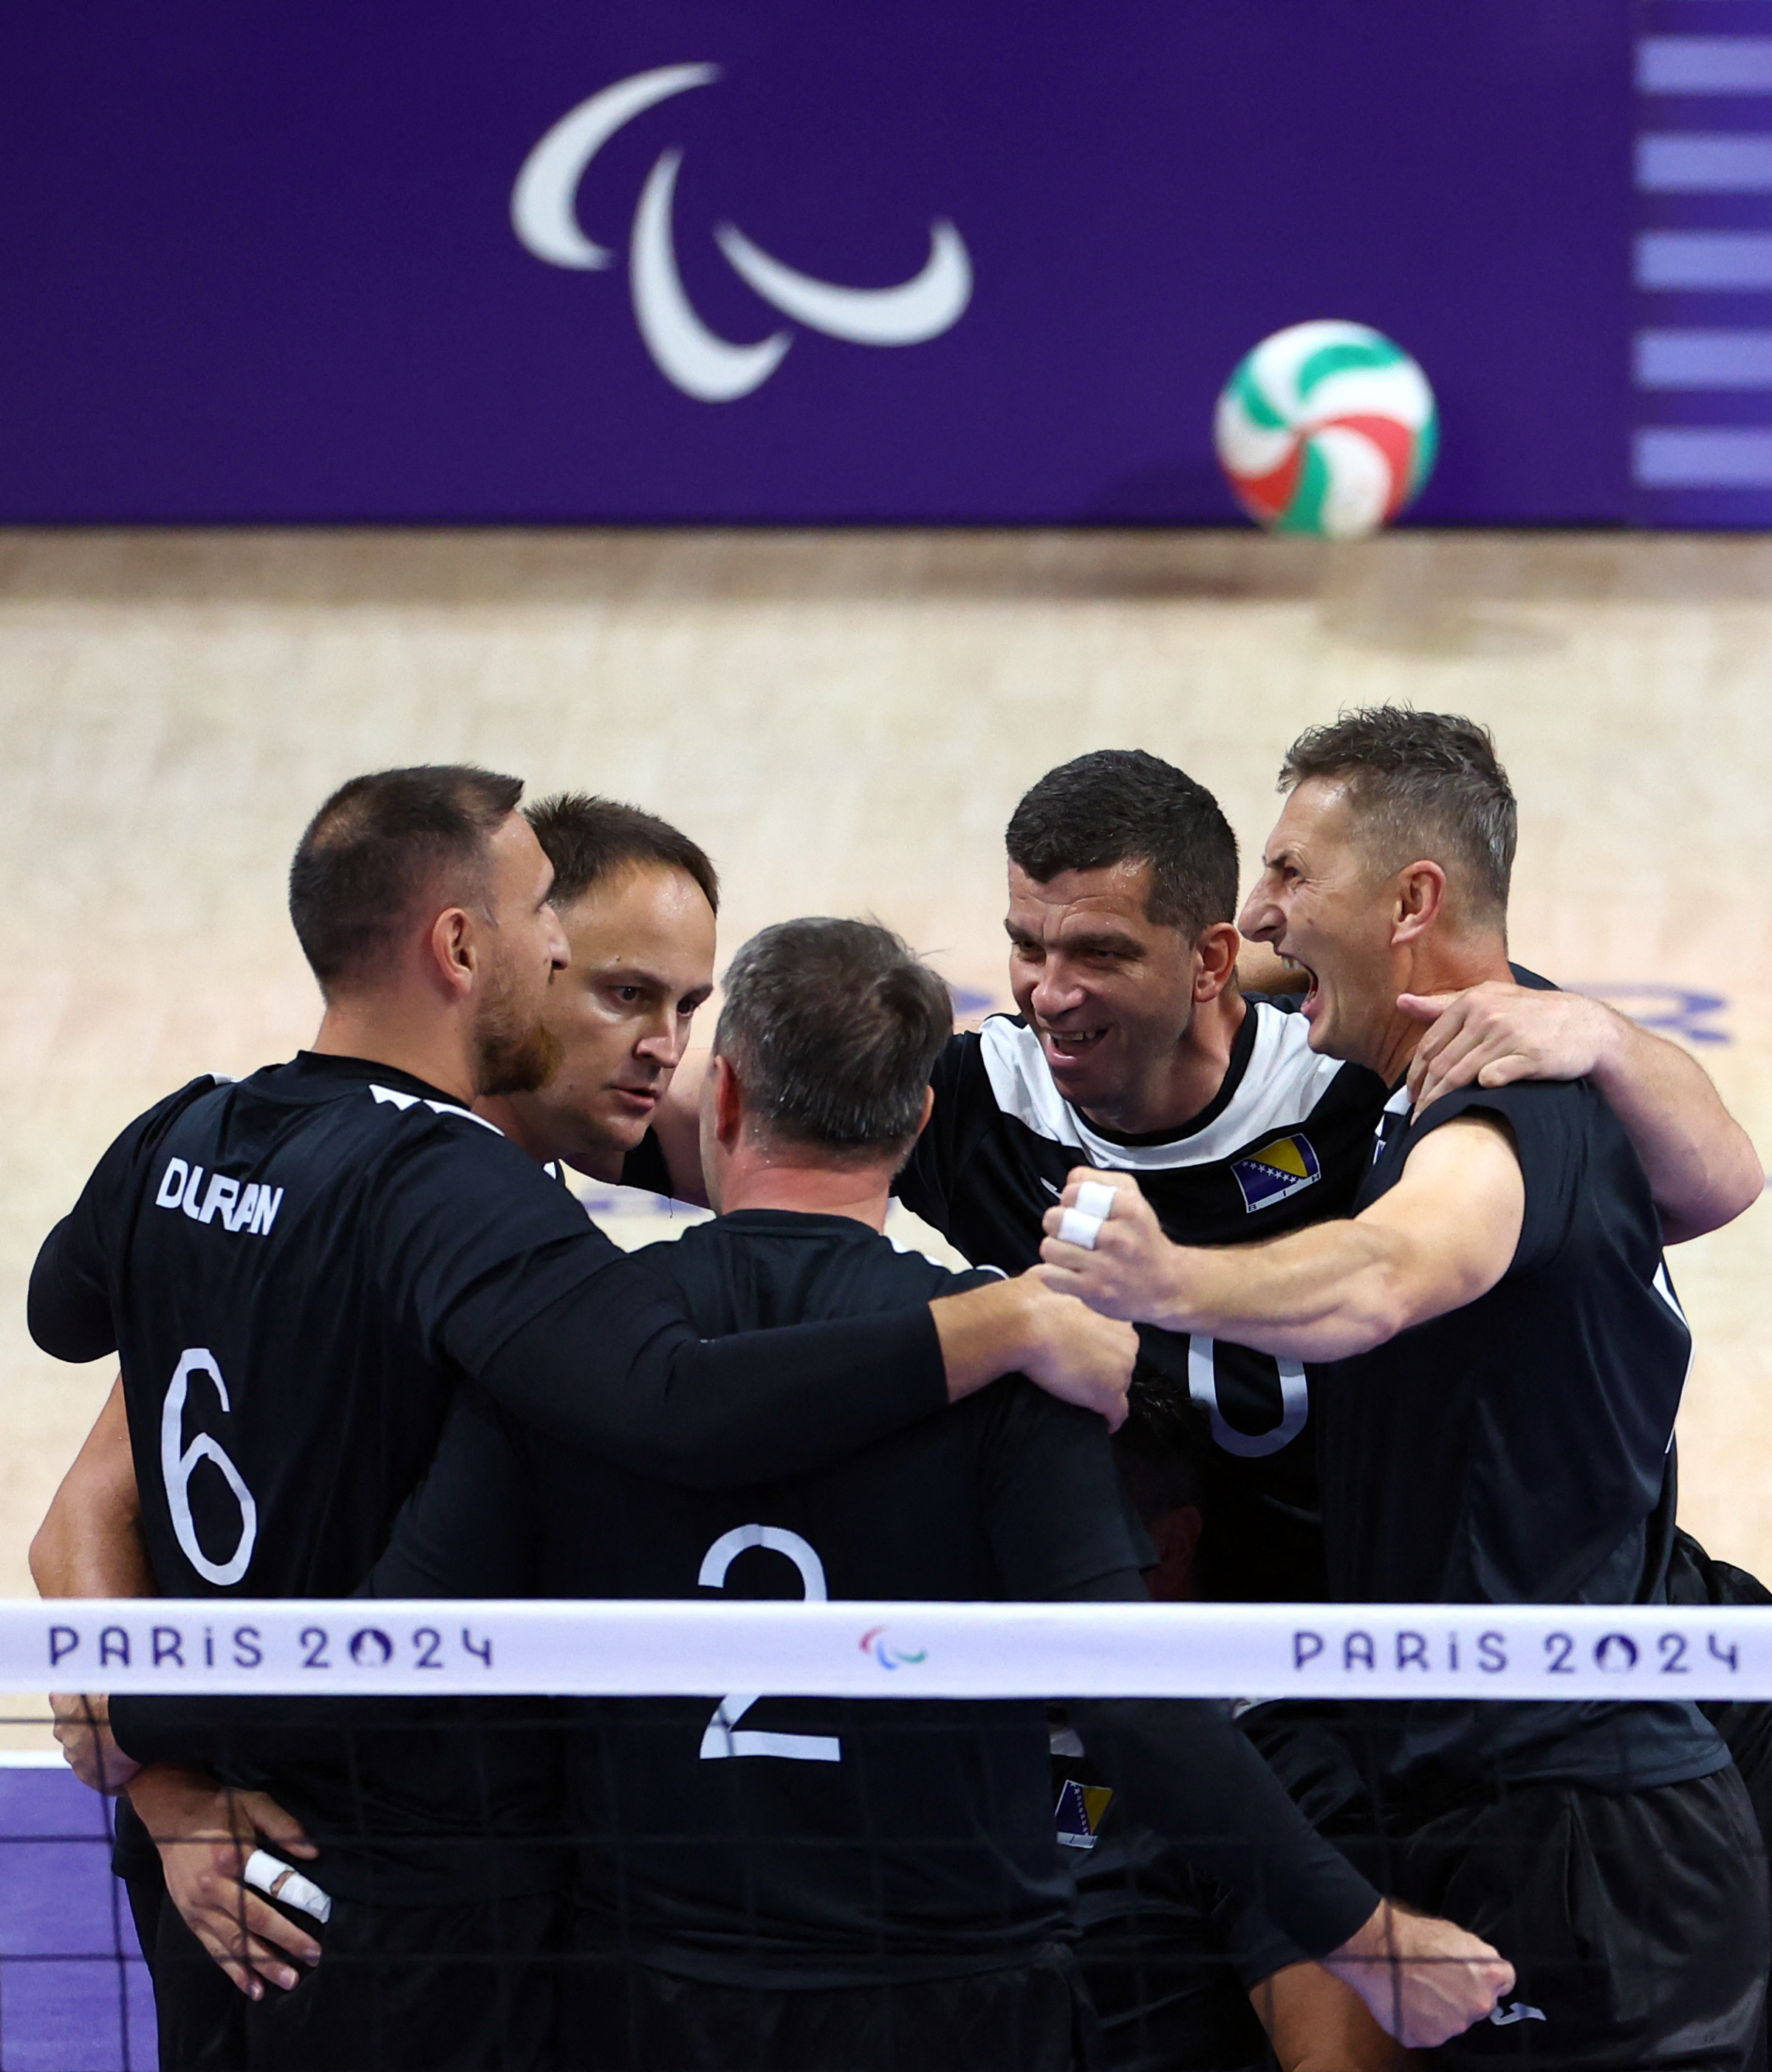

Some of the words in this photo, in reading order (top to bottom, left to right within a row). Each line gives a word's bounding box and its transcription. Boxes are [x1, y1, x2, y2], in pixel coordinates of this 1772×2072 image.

[155, 1157, 284, 1236] DURAN
[161, 1347, 257, 1586] 6
[299, 1627, 493, 1669] 2024
[697, 1523, 841, 1762] 2
[1544, 1632, 1738, 1673] 2024
